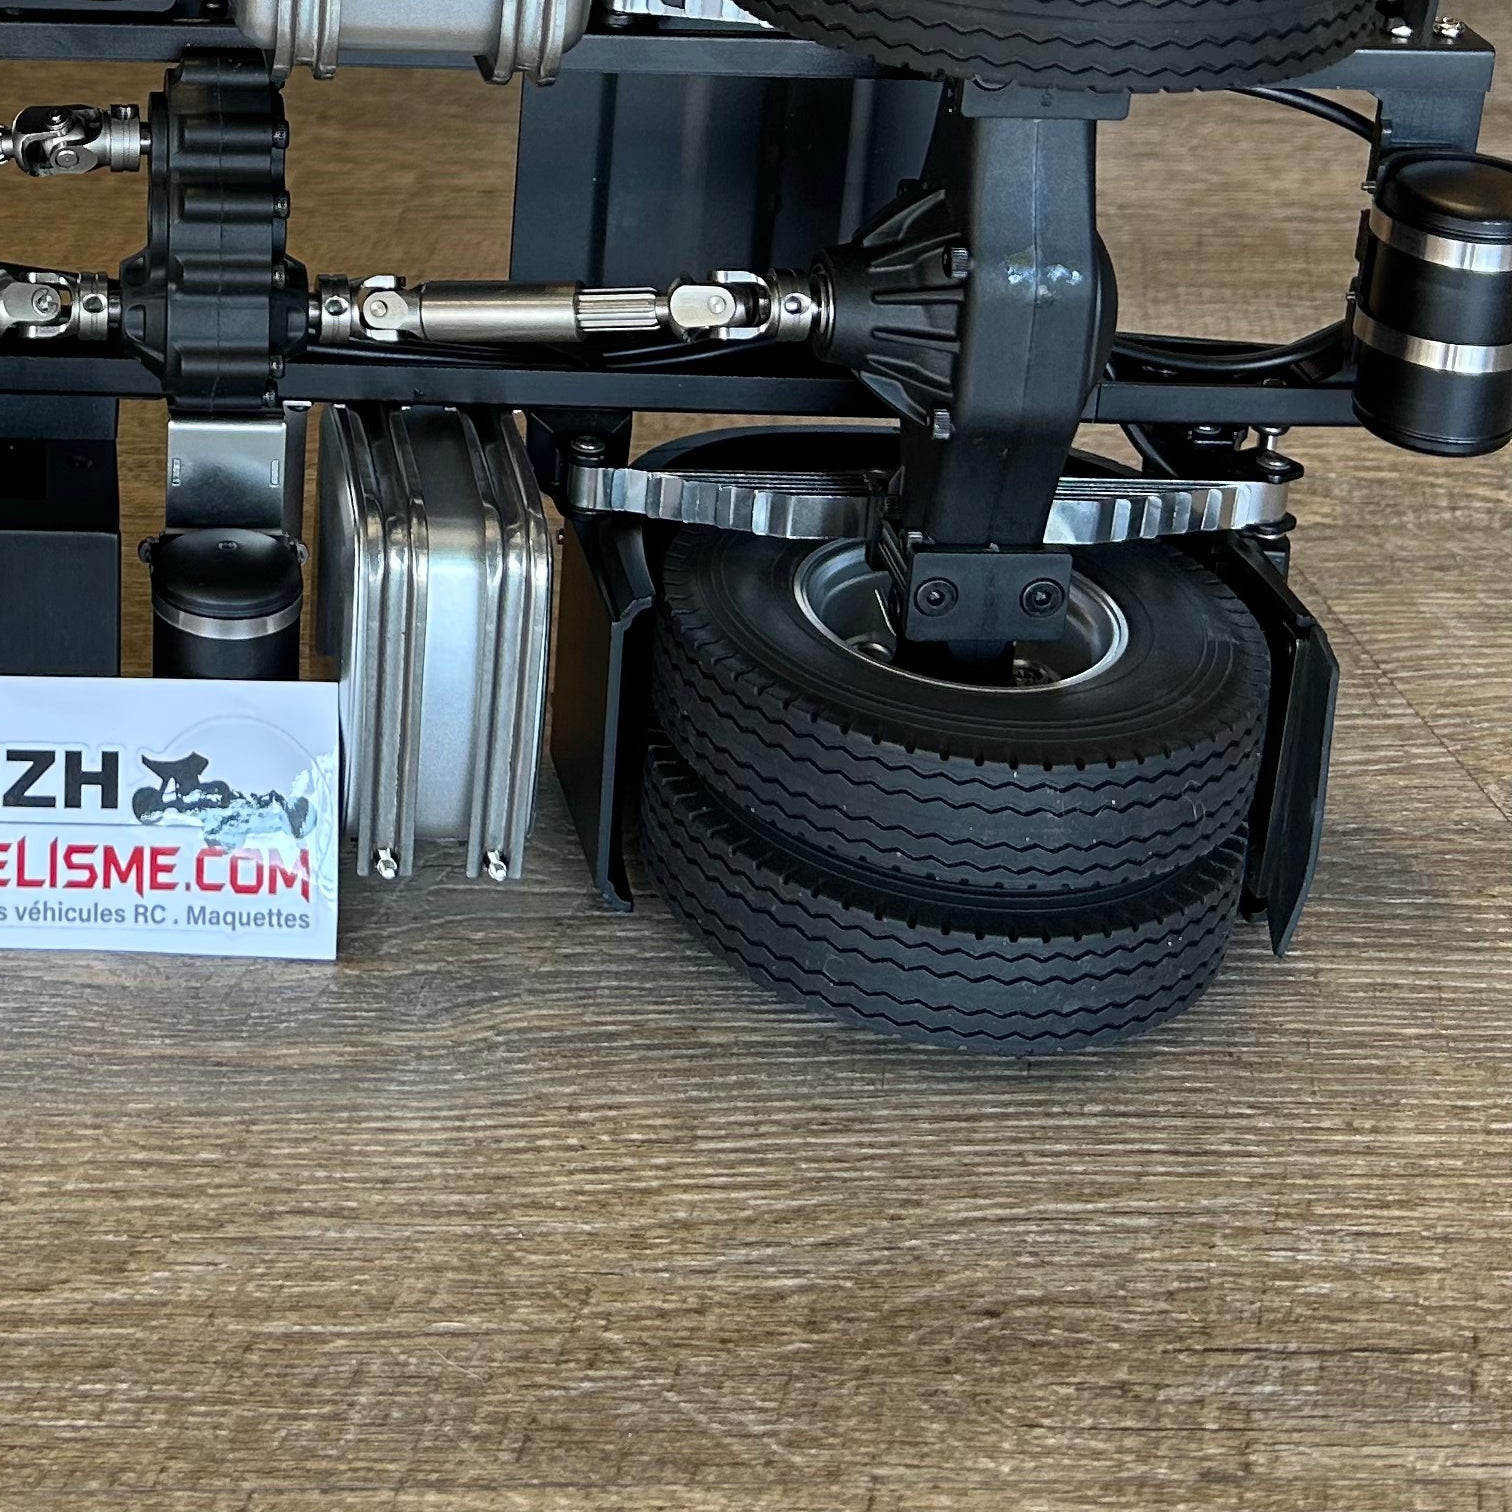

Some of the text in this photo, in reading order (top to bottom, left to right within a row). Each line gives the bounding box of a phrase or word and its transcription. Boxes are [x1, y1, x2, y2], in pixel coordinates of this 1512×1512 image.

[15, 900, 126, 925] véhicules
[134, 903, 167, 925] RC
[187, 905, 310, 932] Maquettes
